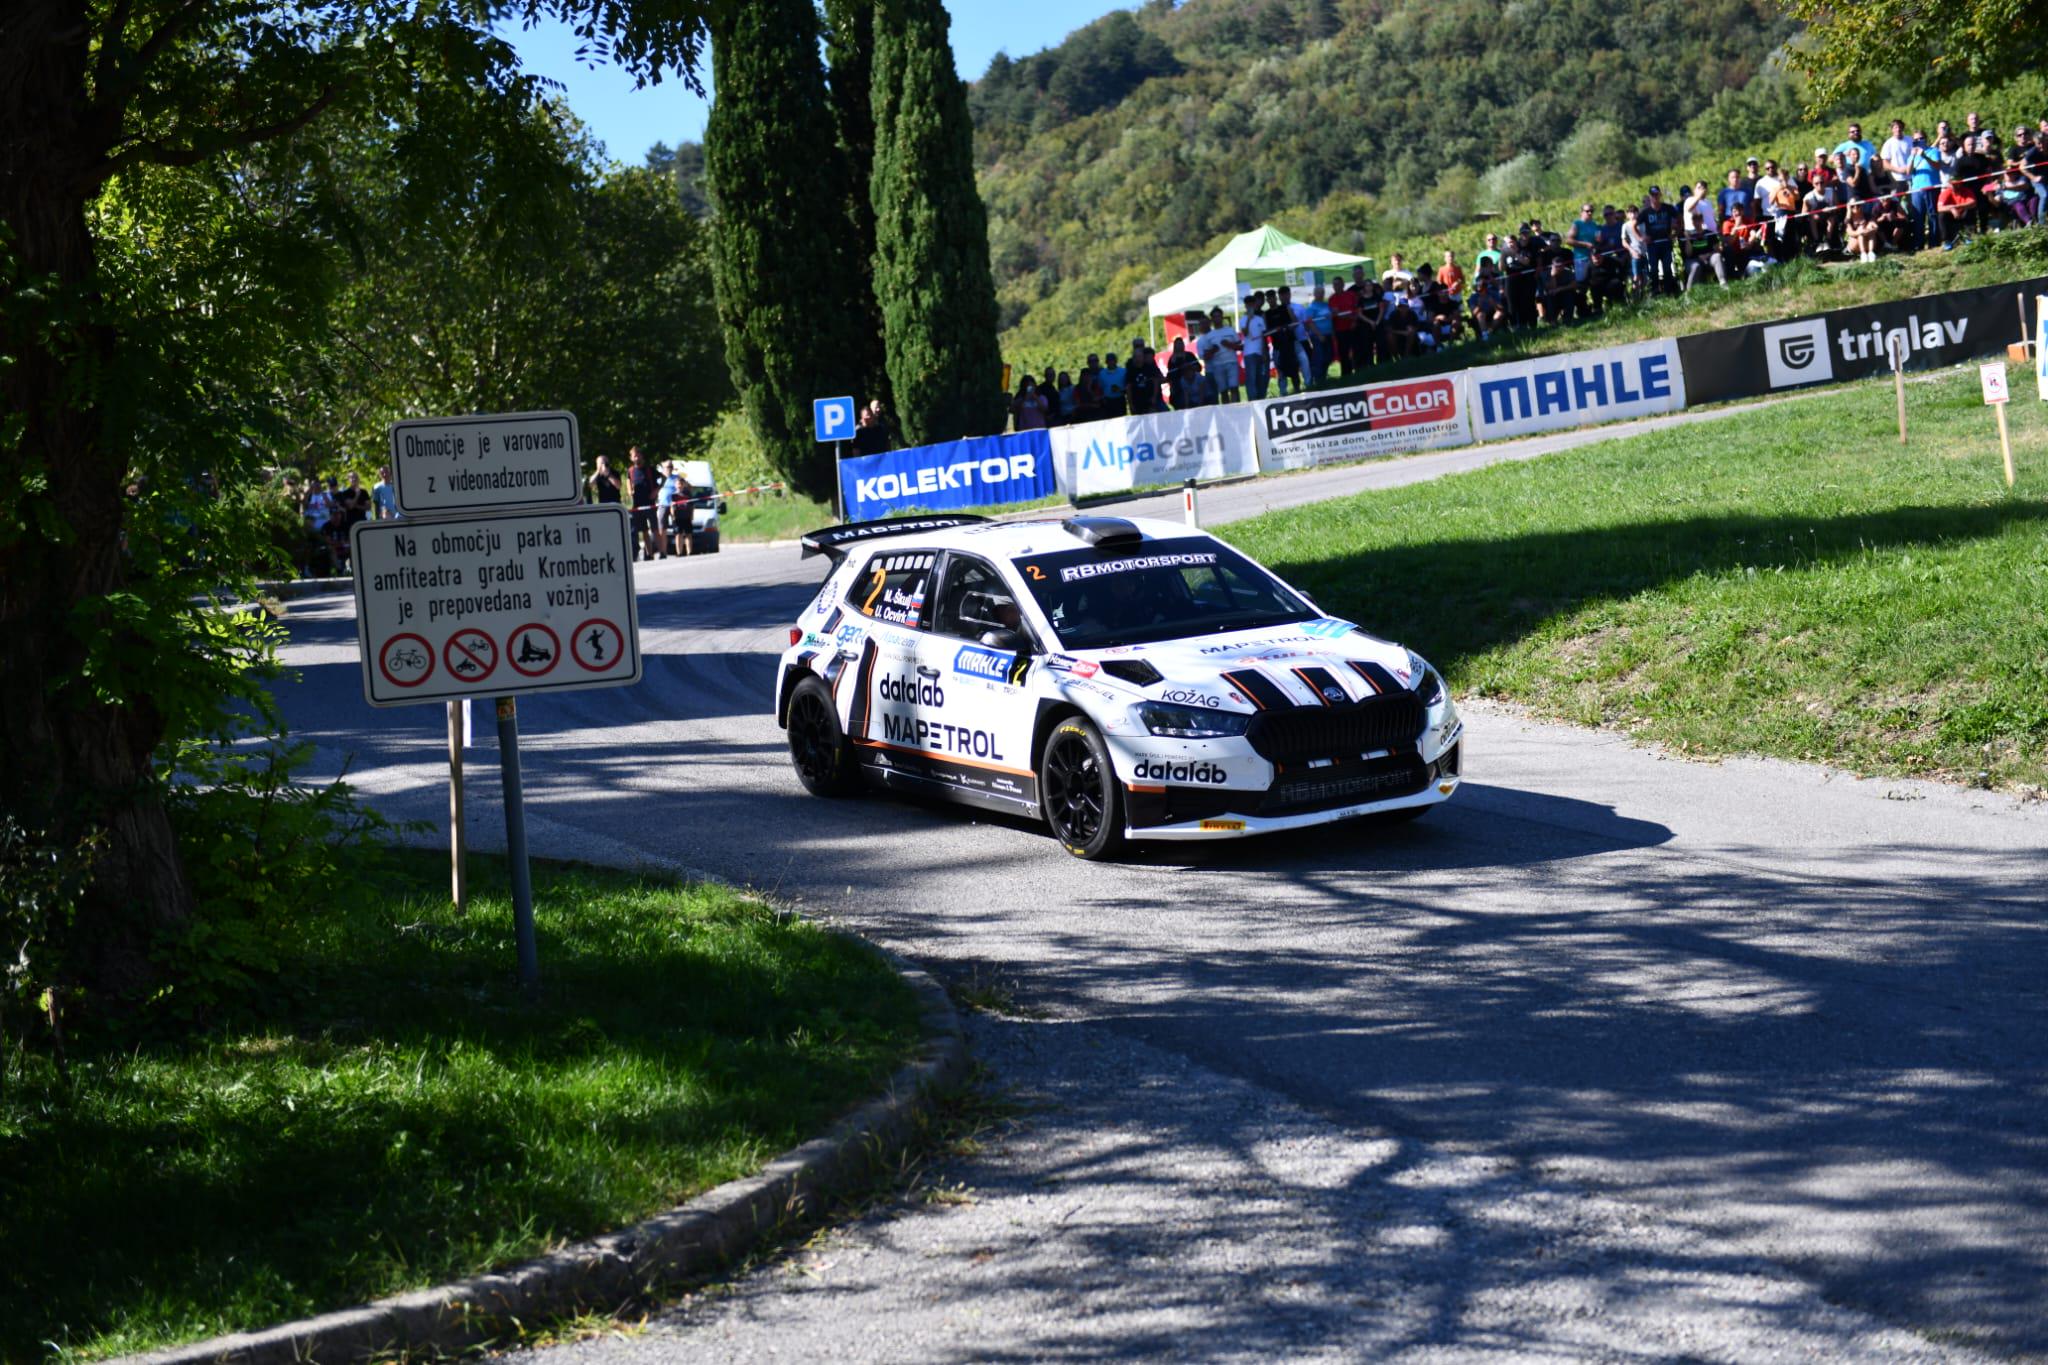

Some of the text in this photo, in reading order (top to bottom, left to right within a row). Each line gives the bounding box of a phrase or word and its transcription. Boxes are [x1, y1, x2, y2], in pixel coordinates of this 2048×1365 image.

[1838, 315, 1969, 371] triglav
[1480, 354, 1671, 425] MAHLE
[824, 403, 844, 434] P
[405, 431, 565, 461] Območje je varovano
[1306, 438, 1327, 449] laki
[1328, 441, 1340, 449] za
[1341, 435, 1369, 446] dom,
[1370, 431, 1394, 441] obrt
[1396, 428, 1407, 438] in
[1408, 422, 1459, 436] industrijo
[1082, 432, 1225, 471] Alpacem
[428, 466, 549, 493] z videonadzorom
[857, 453, 1037, 503] KOLEKTOR
[394, 522, 591, 557] Na območju parka in
[374, 552, 616, 592] amfiteatra gradu Kromberk
[1026, 565, 1047, 581] 2
[1059, 553, 1217, 583] RBMOTORSPORT
[398, 584, 599, 625] je prepovedana vožnja
[862, 568, 887, 617] 2
[883, 589, 893, 603] M.
[875, 604, 883, 617] U.
[957, 650, 1009, 678] MAHLE
[1012, 659, 1028, 687] 2
[879, 673, 945, 708] datalab
[1161, 688, 1220, 708] KOŽAG
[884, 713, 1003, 761] MAPETROL
[1133, 759, 1227, 784] datalab
